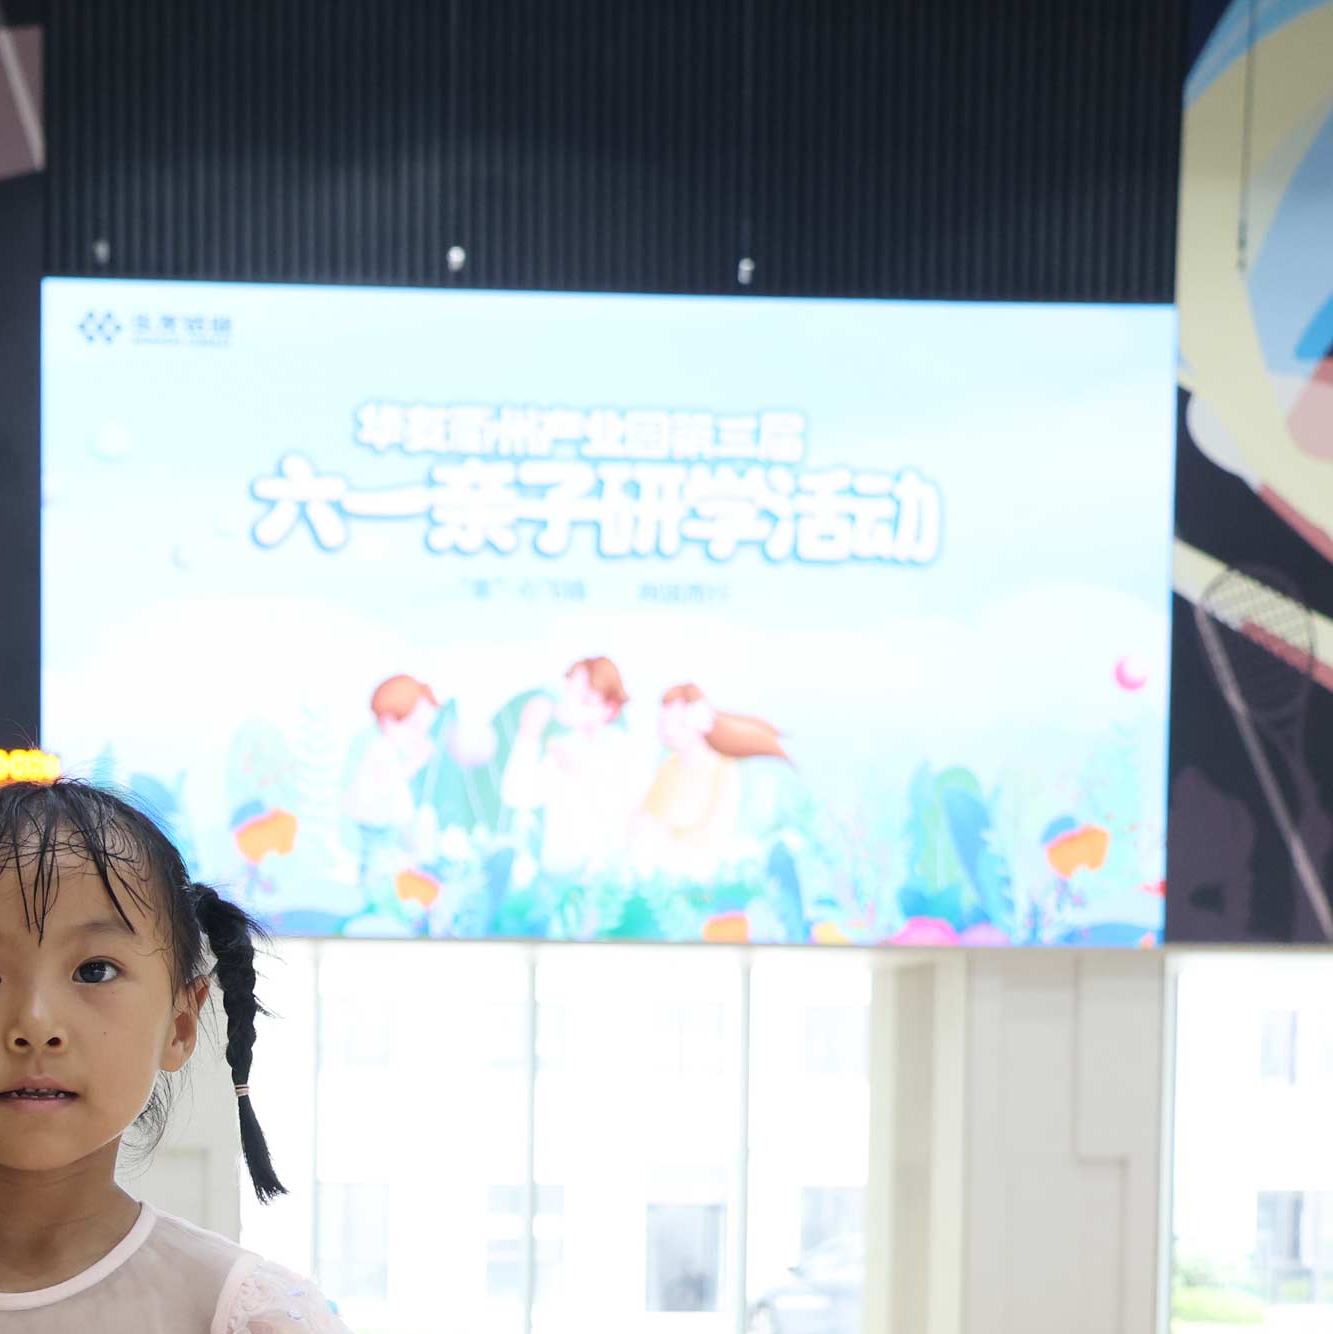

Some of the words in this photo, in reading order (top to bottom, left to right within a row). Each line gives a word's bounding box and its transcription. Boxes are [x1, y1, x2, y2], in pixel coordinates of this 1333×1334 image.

[251, 454, 939, 564] 六一亲子研学活动
